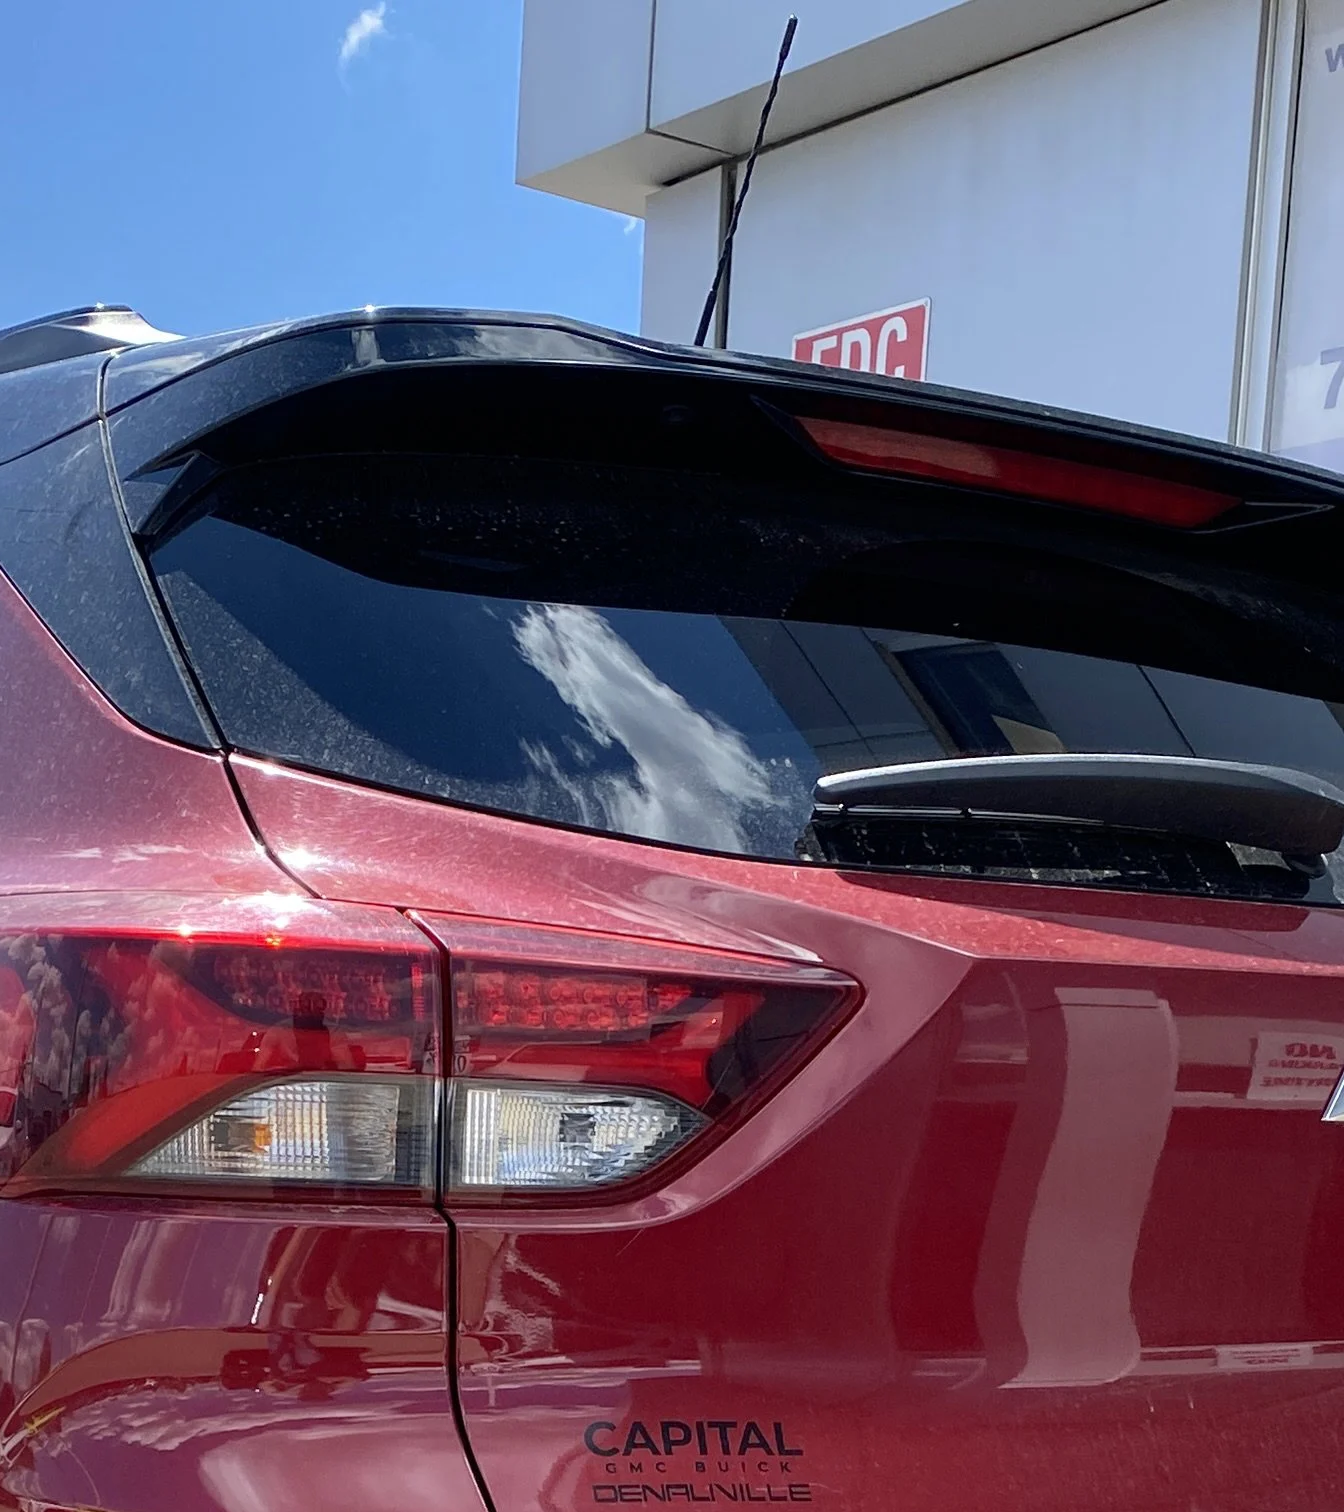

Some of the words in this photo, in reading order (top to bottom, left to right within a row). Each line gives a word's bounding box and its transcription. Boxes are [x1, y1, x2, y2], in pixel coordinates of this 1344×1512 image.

[584, 1421, 803, 1457] CAPITAL
[606, 1462, 666, 1474] GMC
[696, 1462, 792, 1474] BUICK
[593, 1484, 812, 1503] DENALIVILLE
